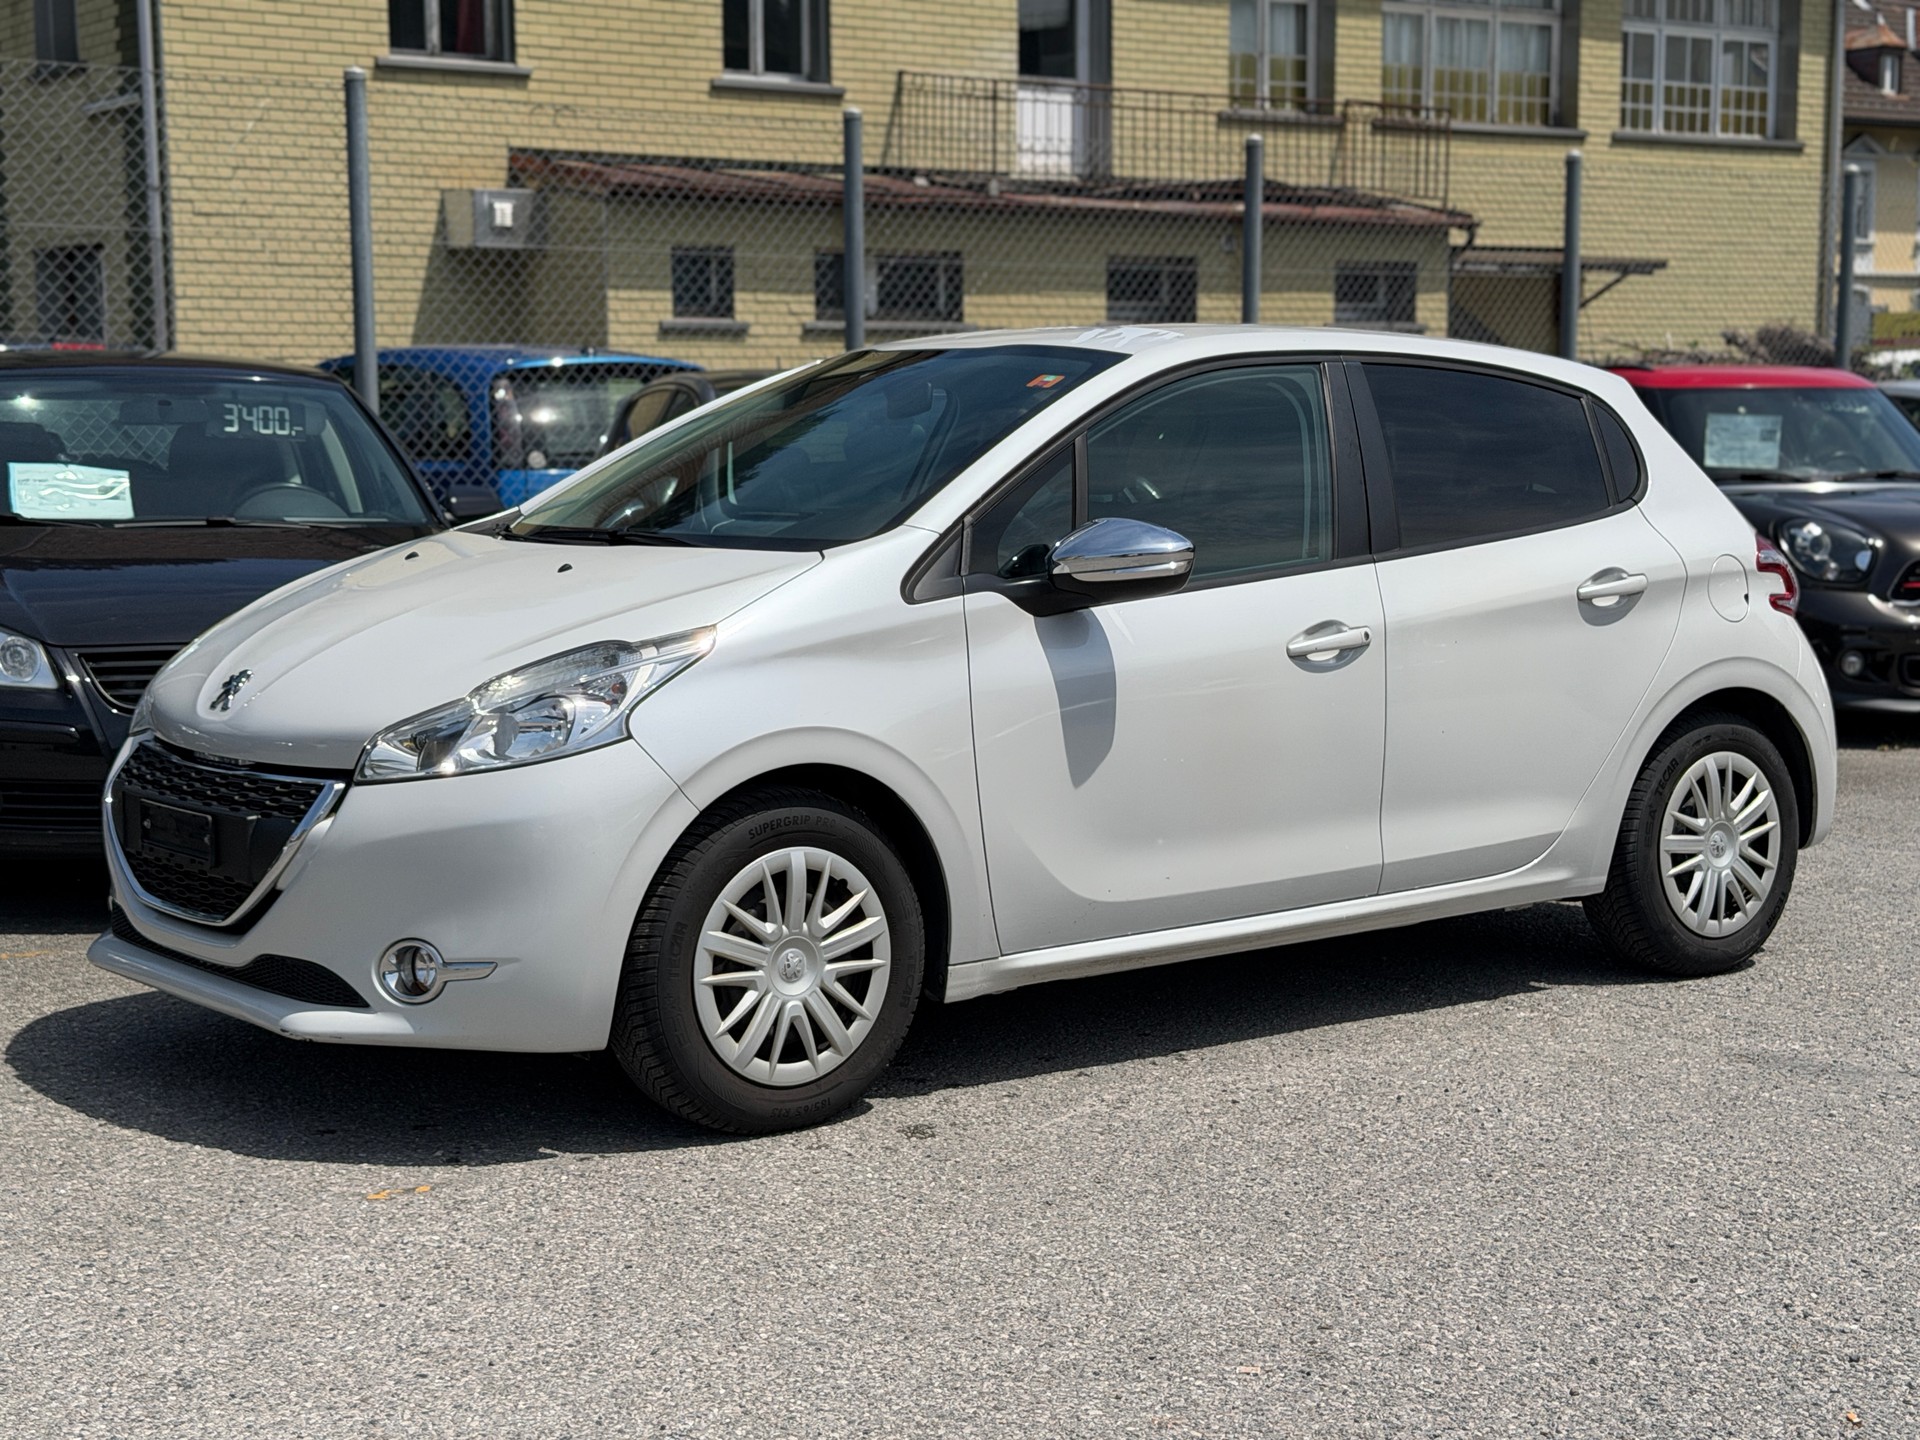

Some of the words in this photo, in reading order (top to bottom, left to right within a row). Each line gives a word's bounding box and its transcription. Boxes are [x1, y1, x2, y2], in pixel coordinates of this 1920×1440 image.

[1655, 757, 1680, 797] TECAR
[747, 814, 811, 840] SUPERGRIP
[815, 815, 837, 828] PRO
